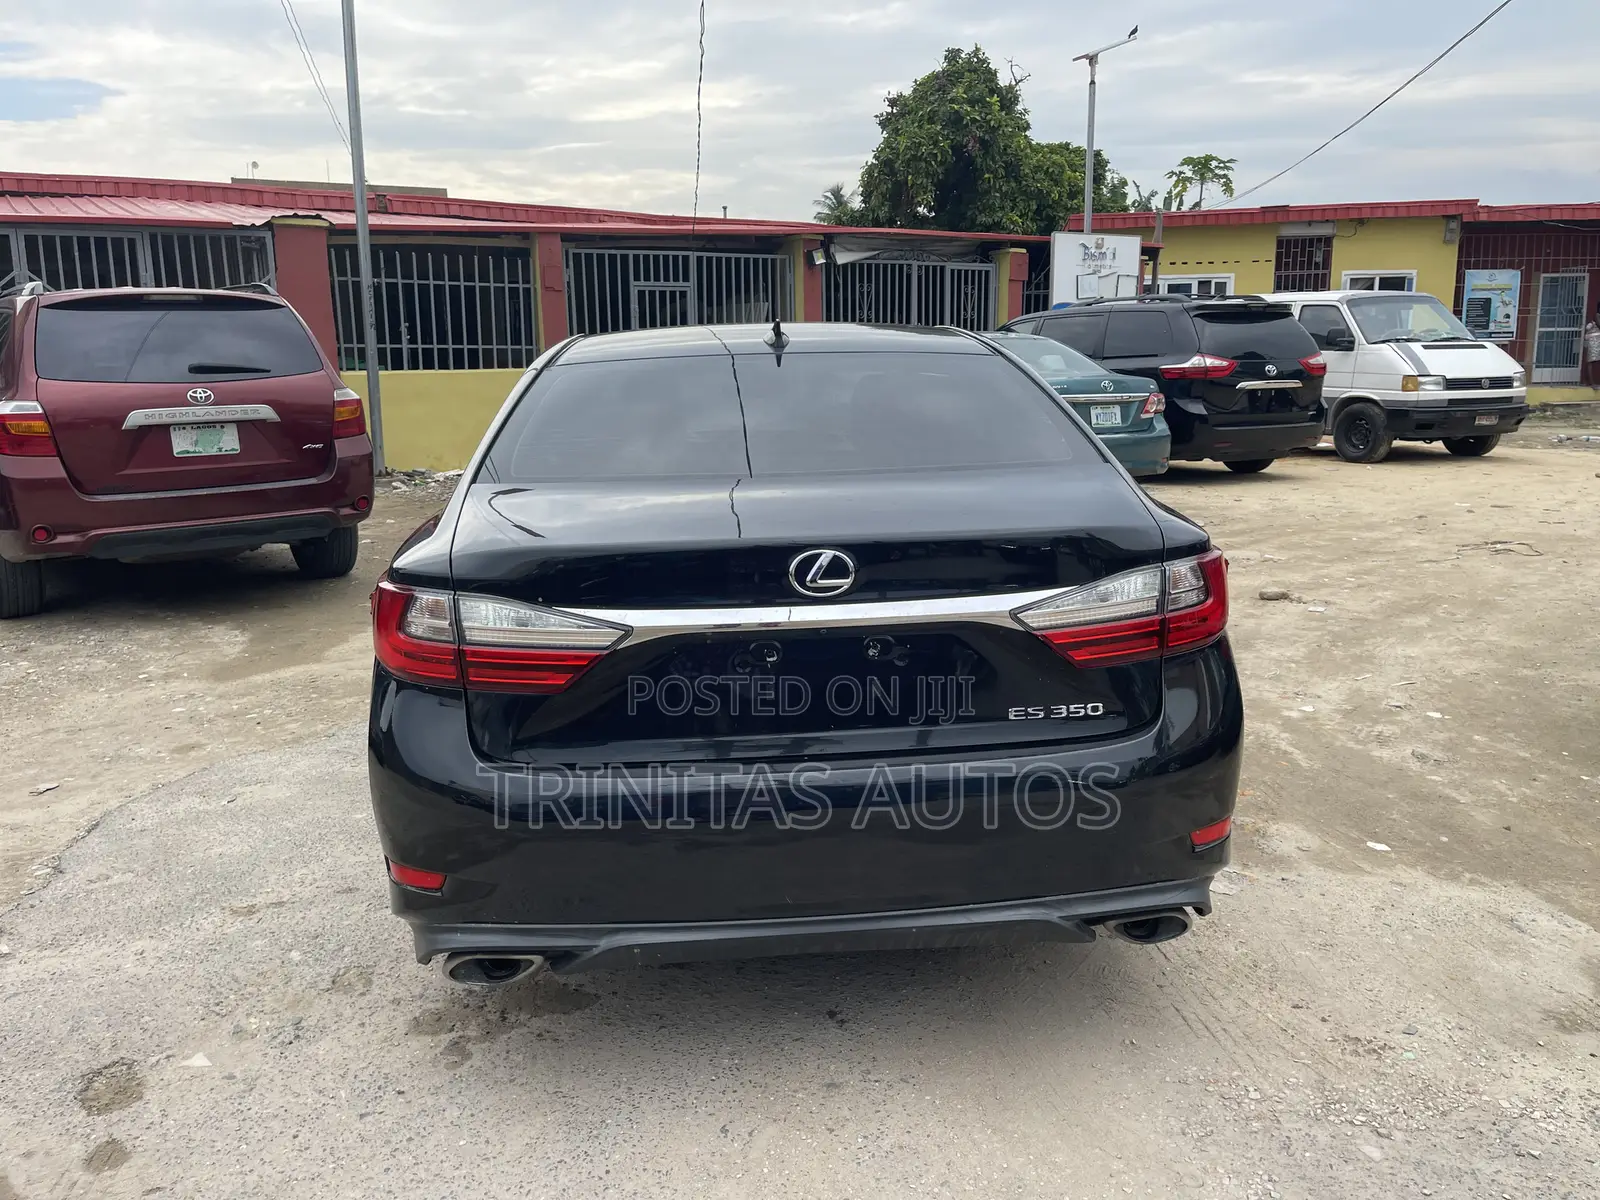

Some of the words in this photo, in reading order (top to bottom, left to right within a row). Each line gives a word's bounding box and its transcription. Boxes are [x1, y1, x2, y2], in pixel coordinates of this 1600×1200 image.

[144, 408, 261, 420] HIGHLANDER
[1008, 706, 1045, 720] ES
[1050, 702, 1104, 718] 350
